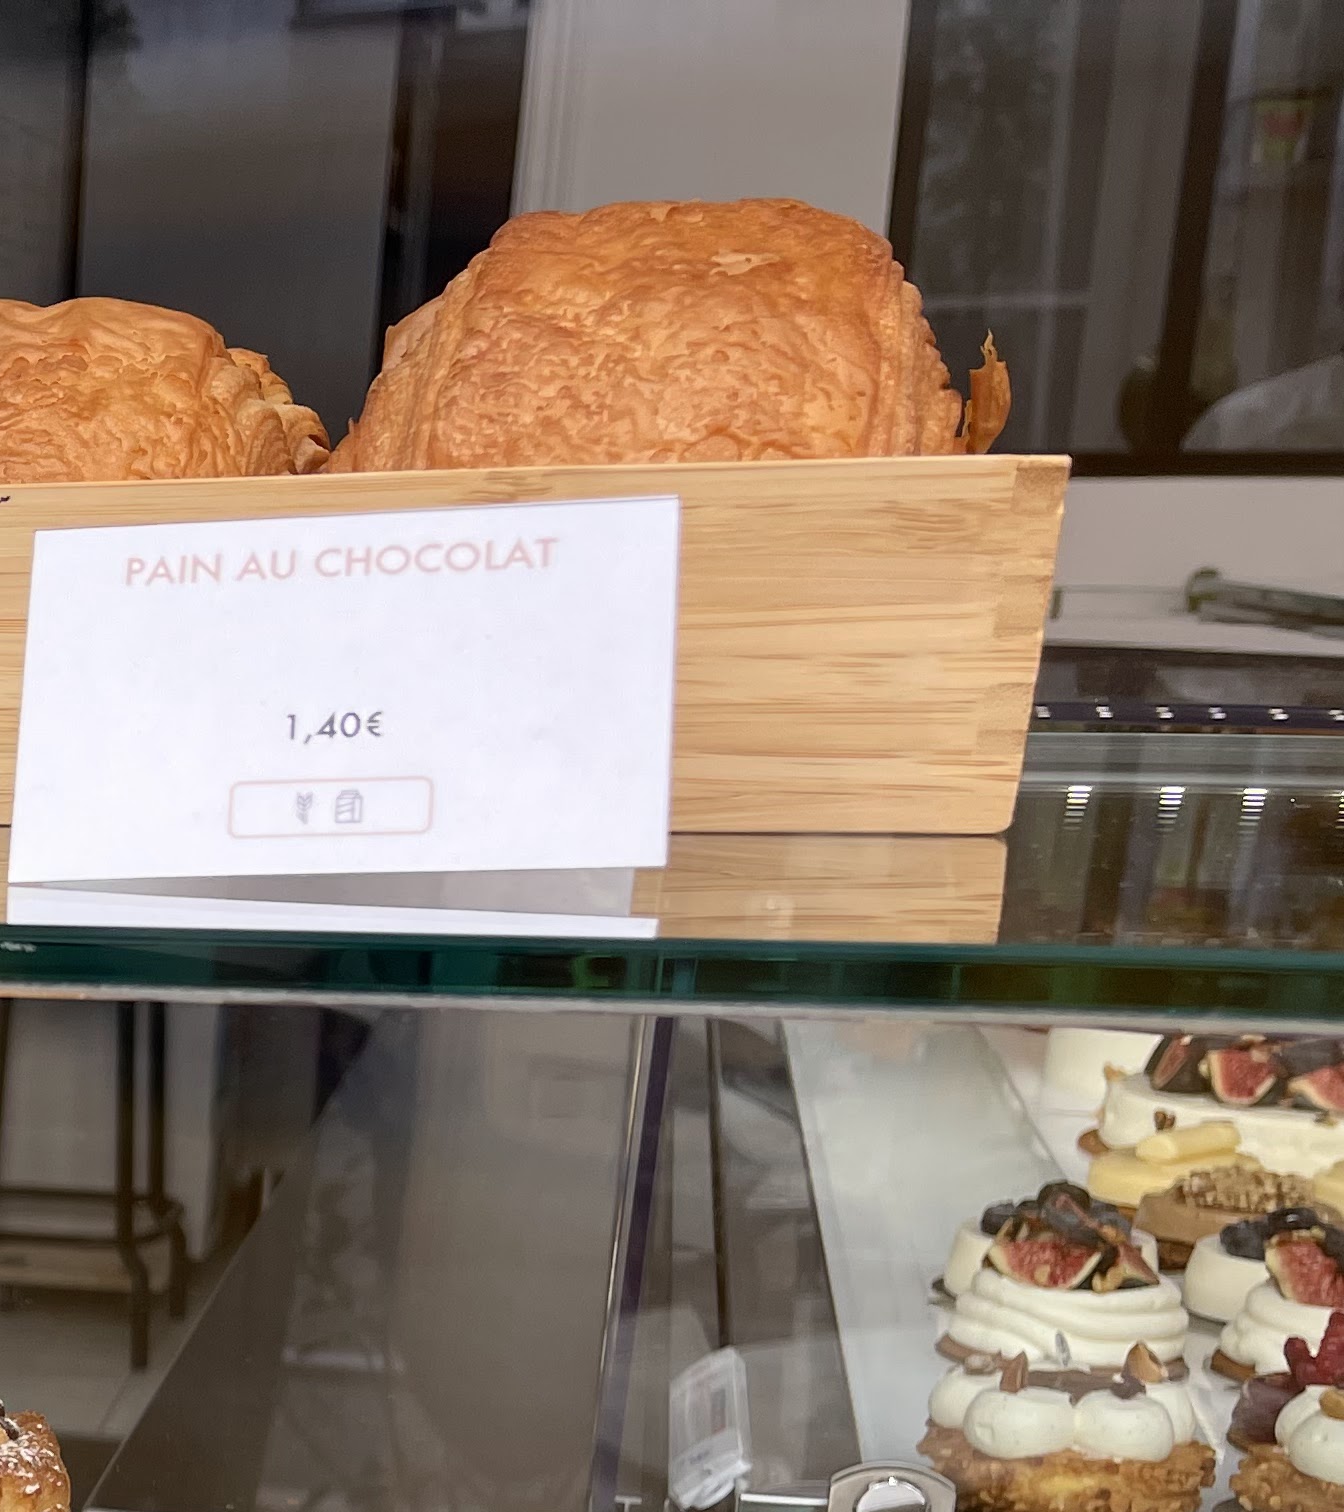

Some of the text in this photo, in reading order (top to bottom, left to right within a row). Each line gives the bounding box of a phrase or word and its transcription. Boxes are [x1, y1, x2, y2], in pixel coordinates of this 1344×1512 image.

[125, 536, 561, 587] PAIN AU CHOCOLAT
[287, 711, 383, 745] 1,40€
